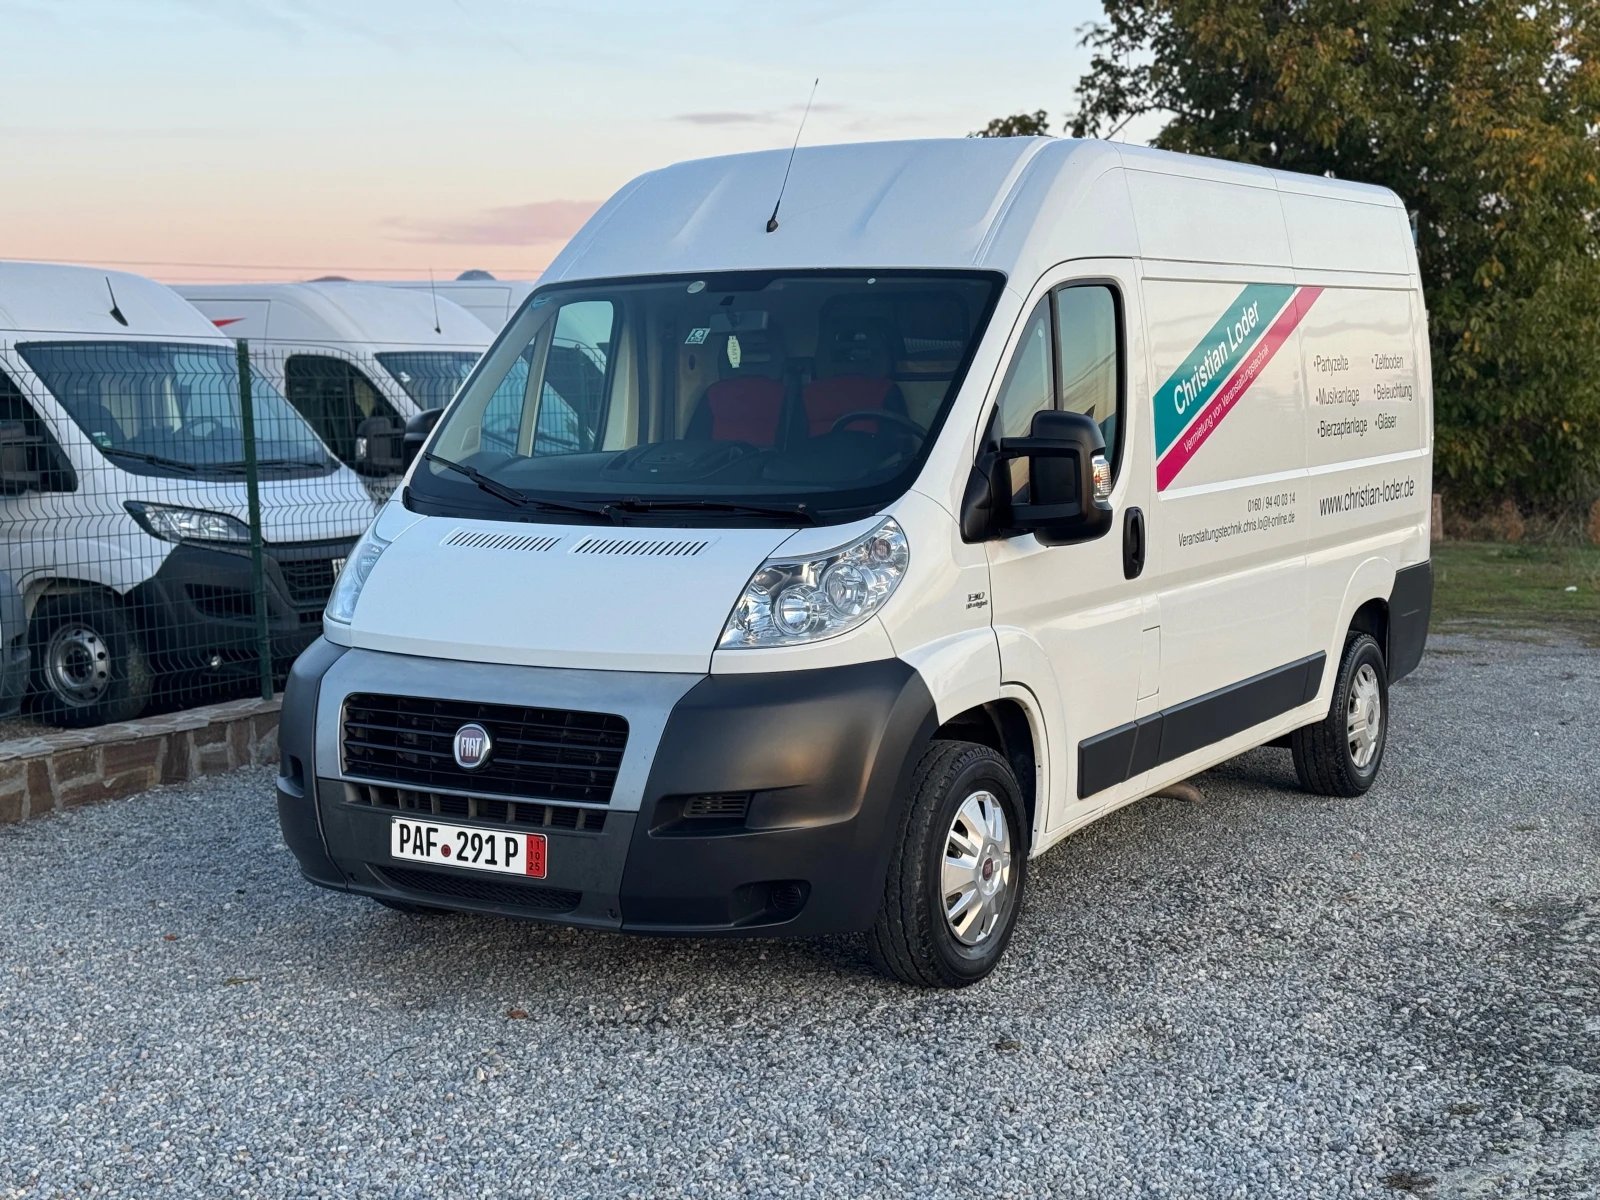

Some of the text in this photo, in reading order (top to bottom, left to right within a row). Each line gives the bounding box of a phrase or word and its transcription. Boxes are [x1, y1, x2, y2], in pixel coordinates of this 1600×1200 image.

[1174, 300, 1260, 415] Christian Loder
[1316, 354, 1349, 376] Partyzelte
[1183, 343, 1270, 453] Vermietung von Veranstaltungstechnik
[1318, 386, 1360, 406] Musikanlage
[1376, 383, 1412, 401] Beleuchtung
[1320, 417, 1367, 439] Bierzapfanlage
[1377, 412, 1397, 430] Gläser
[1247, 497, 1262, 512] 0160
[1265, 496, 1273, 509] 94
[1273, 494, 1281, 507] 40
[1289, 491, 1296, 504] 14
[1319, 475, 1415, 516] www.christian-loder.de
[1178, 510, 1296, 547] Veranstaltungstechnik.chris.lo@t-online.de
[461, 736, 483, 757] FIAT
[399, 823, 519, 868] PAF 291 P
[529, 839, 541, 850] 11
[528, 861, 541, 871] 25
[529, 850, 541, 861] 10
